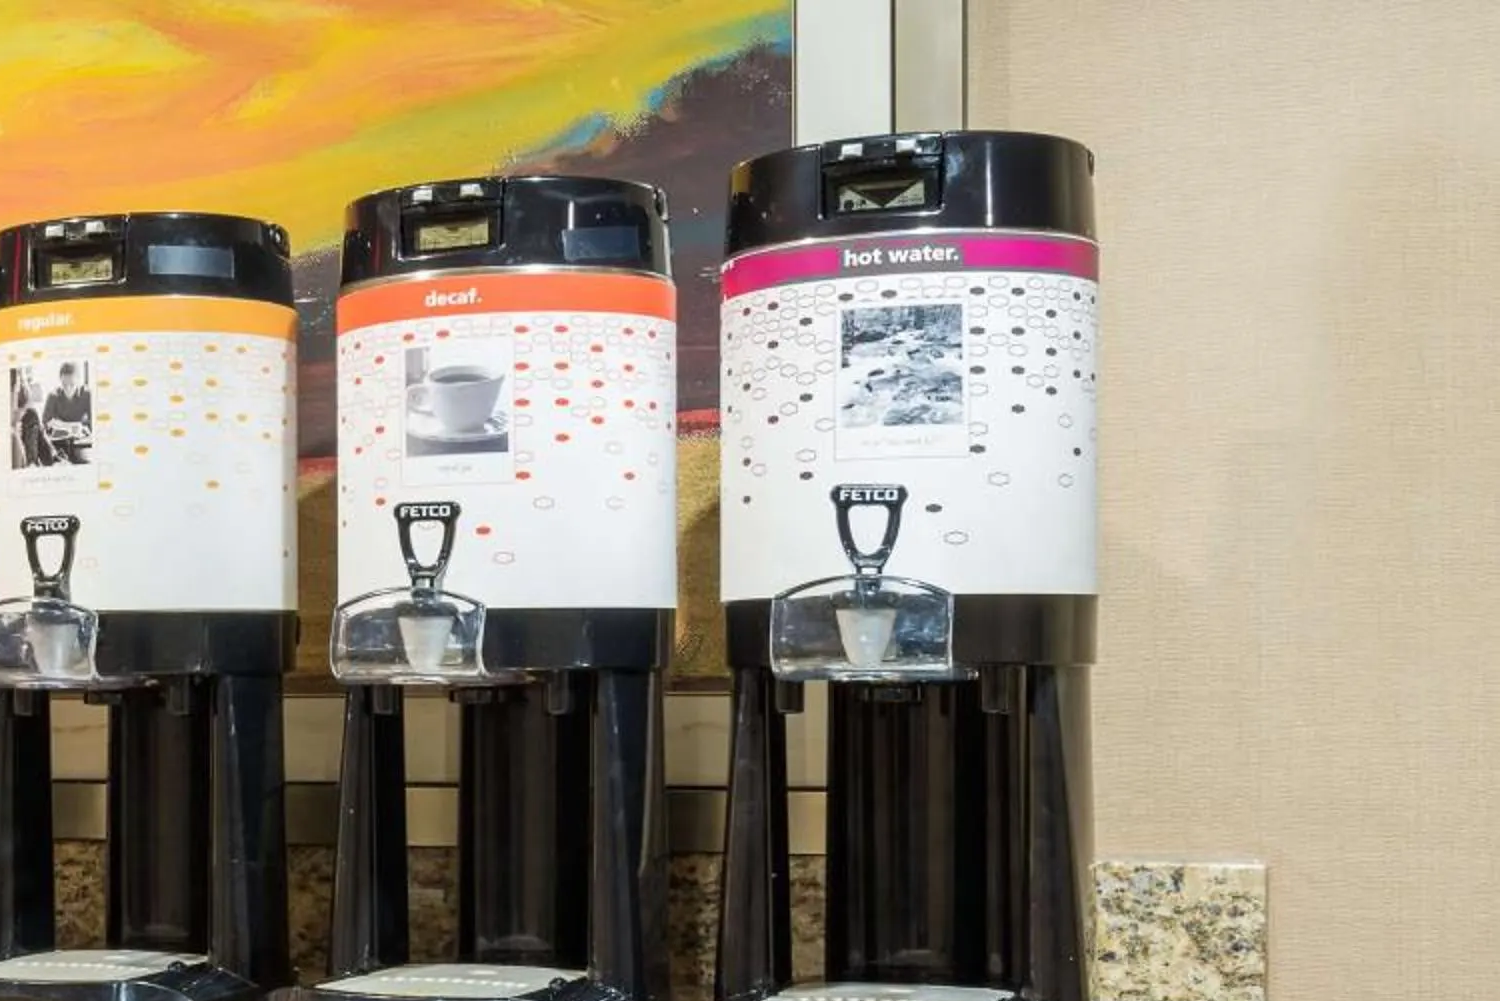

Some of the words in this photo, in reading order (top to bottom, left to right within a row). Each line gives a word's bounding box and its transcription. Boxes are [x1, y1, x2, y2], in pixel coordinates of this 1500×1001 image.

[843, 248, 883, 267] hot
[888, 245, 959, 264] water.
[425, 287, 483, 307] decaf.
[840, 489, 899, 501] FETCO
[400, 505, 451, 518] FETCO
[25, 519, 69, 532] FETCO
